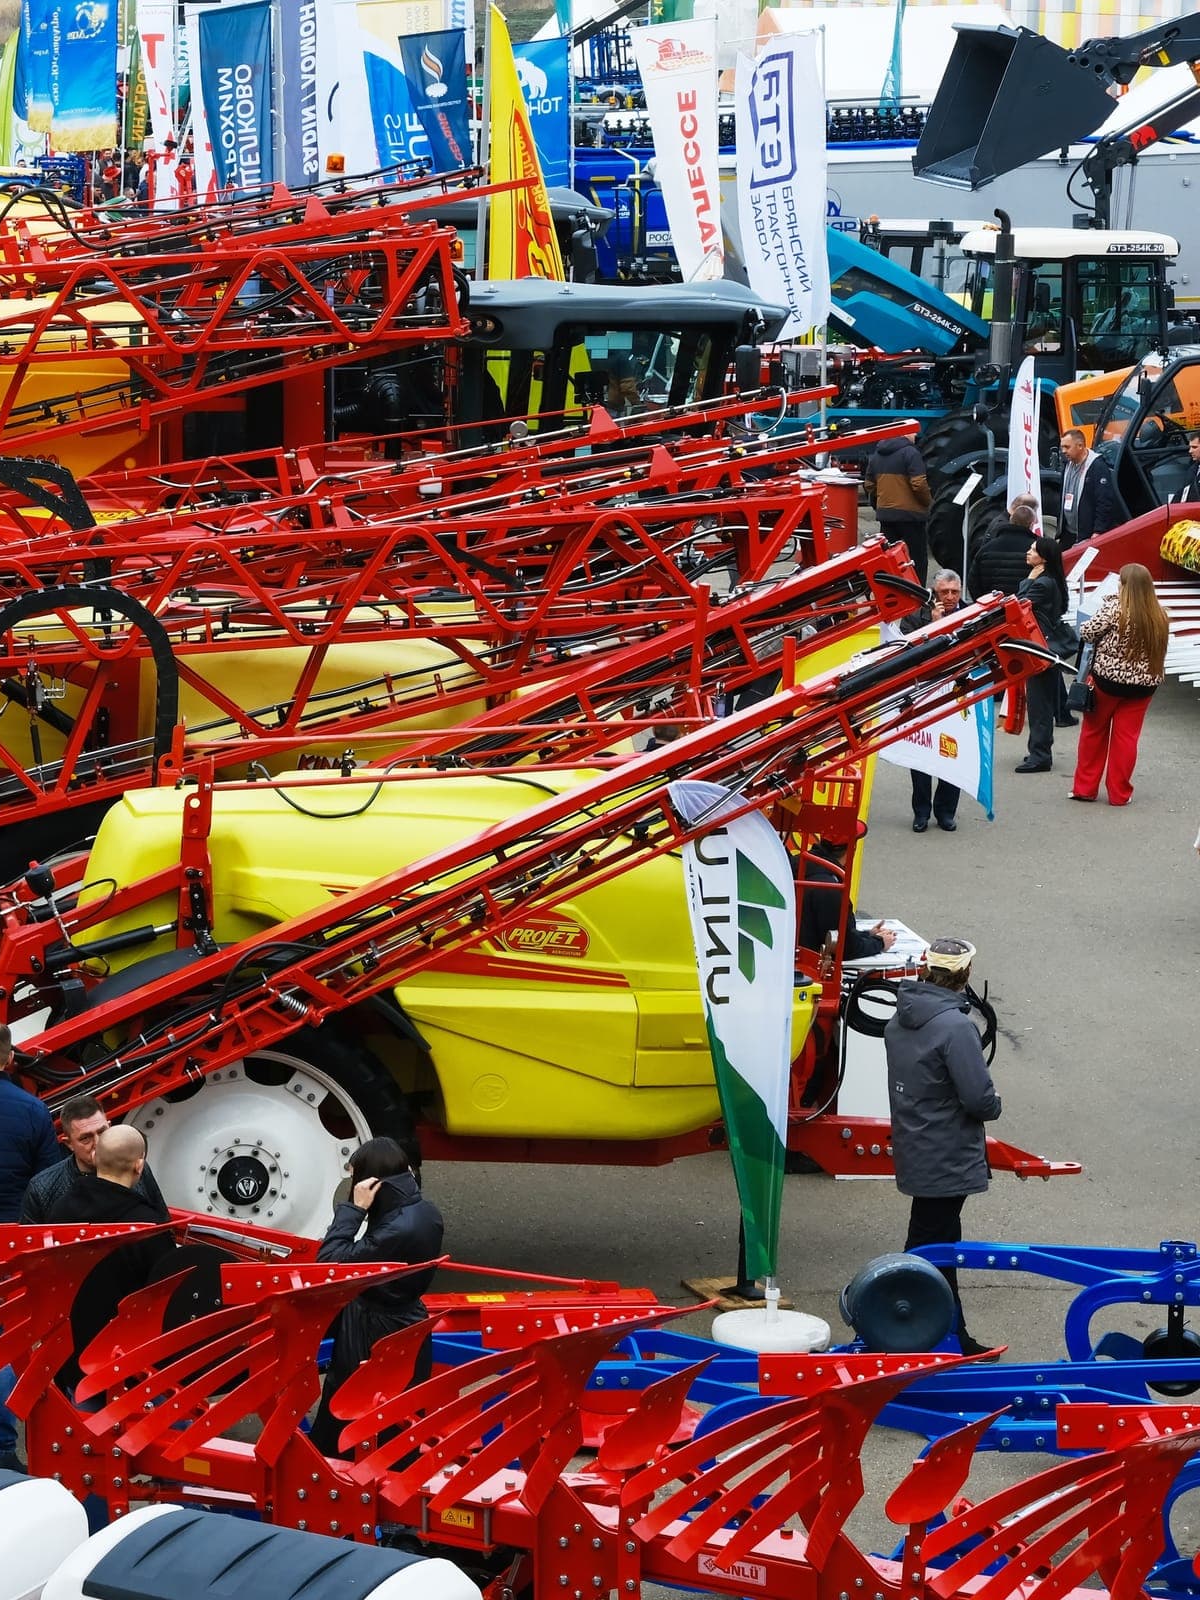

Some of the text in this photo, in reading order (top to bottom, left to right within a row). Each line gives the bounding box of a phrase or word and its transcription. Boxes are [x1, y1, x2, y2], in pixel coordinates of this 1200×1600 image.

[766, 190, 802, 323] ТРАКТОРНЫЙ
[782, 186, 812, 294] БРЯНСКИЙ
[508, 926, 581, 949] PROJET
